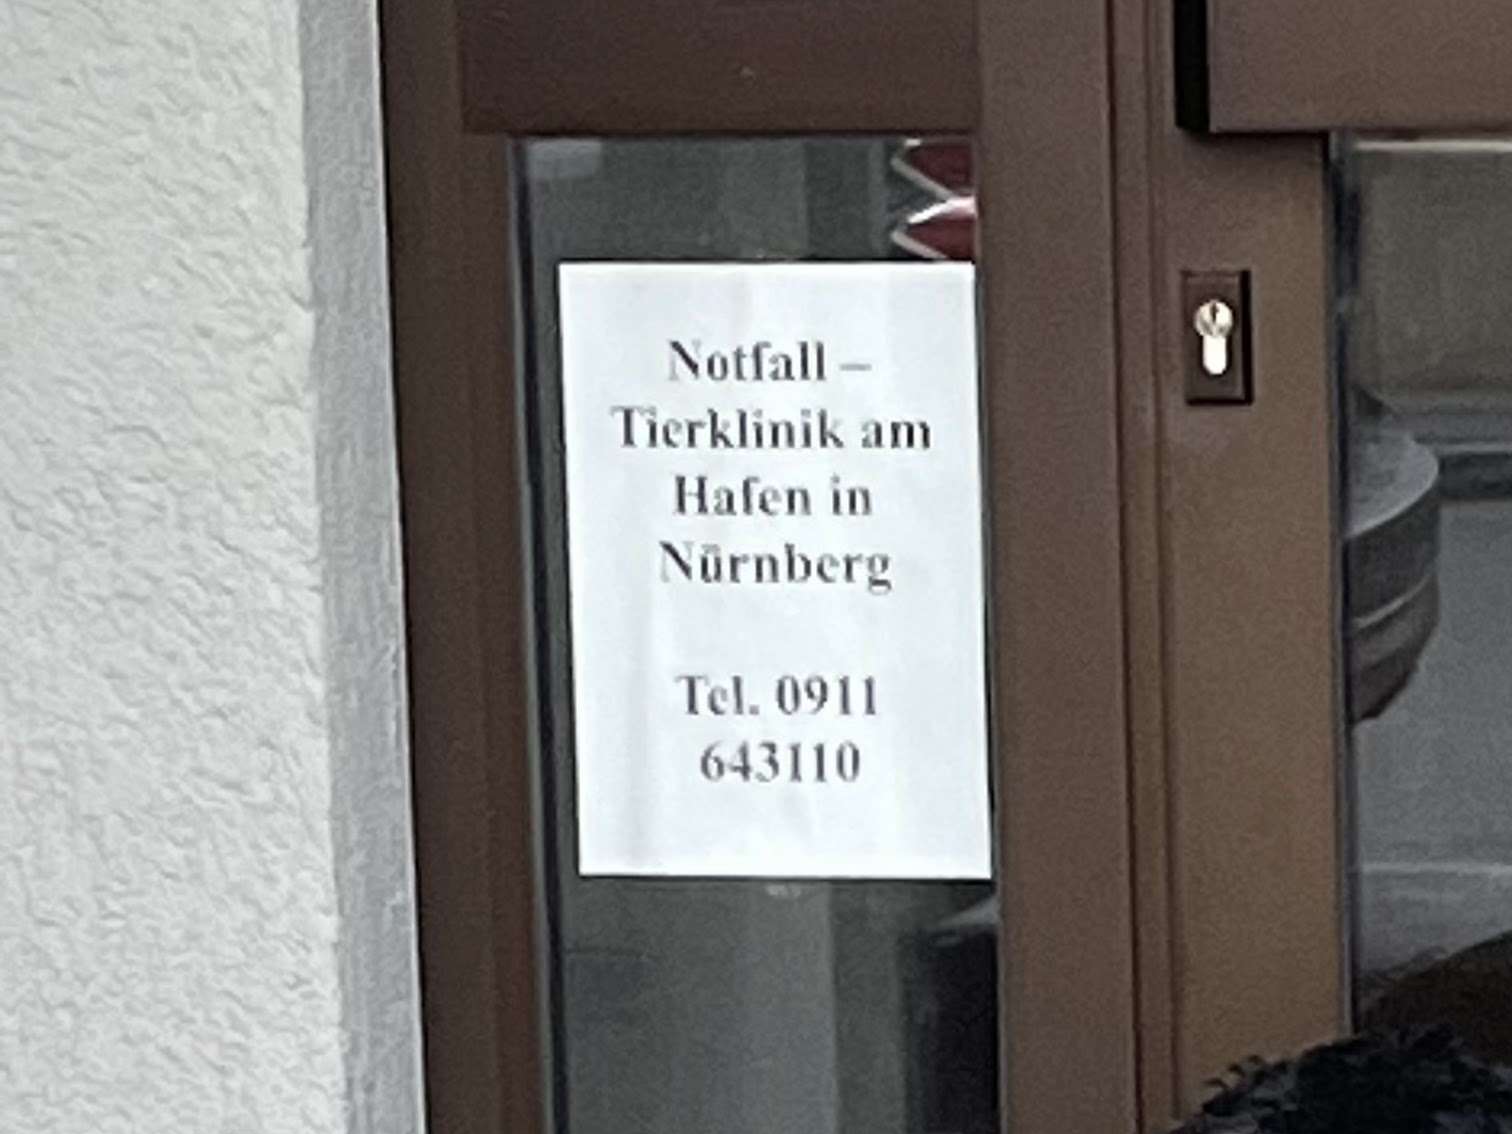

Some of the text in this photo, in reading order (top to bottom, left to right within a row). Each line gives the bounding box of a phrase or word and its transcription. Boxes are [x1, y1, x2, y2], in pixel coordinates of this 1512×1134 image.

[668, 340, 826, 382] Notfall
[612, 405, 932, 450] Tierklinik am
[673, 475, 872, 517] Hafen in
[660, 540, 892, 595] Nürnberg
[675, 674, 877, 718] Tel. 0911
[700, 742, 862, 783] 643110
